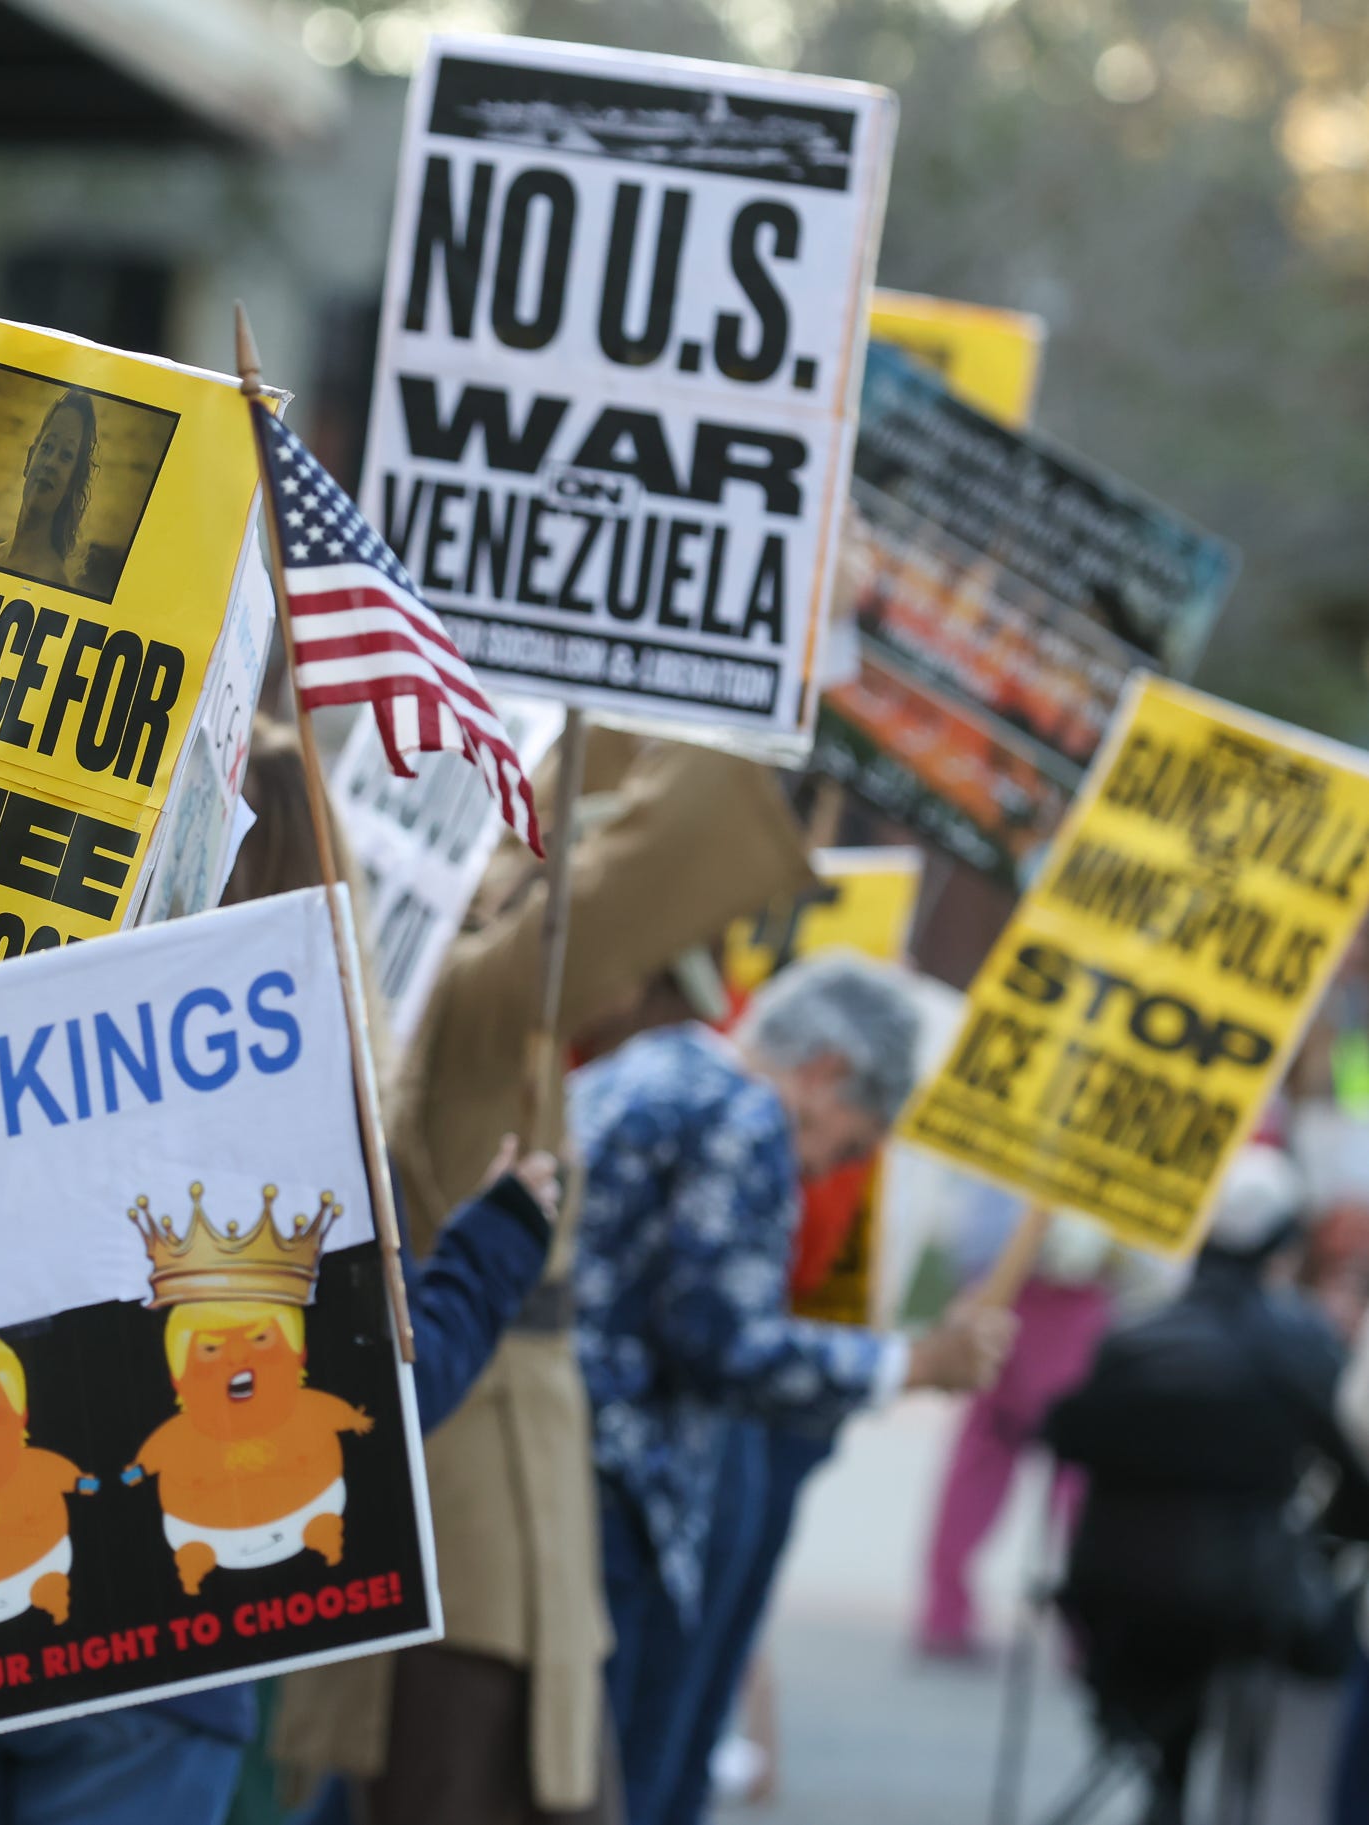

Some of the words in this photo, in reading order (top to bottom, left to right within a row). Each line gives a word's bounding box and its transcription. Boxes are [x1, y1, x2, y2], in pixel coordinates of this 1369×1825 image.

[402, 155, 577, 352] NO
[598, 181, 819, 391] U.S.
[398, 373, 810, 518] WAR
[556, 476, 622, 505] ON
[383, 472, 786, 647] VENEZUELA
[37, 610, 185, 788] FOR
[609, 642, 639, 688] &
[1003, 943, 1276, 1069] STOP
[42, 1625, 158, 1679] RIGHT
[169, 1611, 222, 1652] TO
[233, 1571, 404, 1637] CHOOSE!
